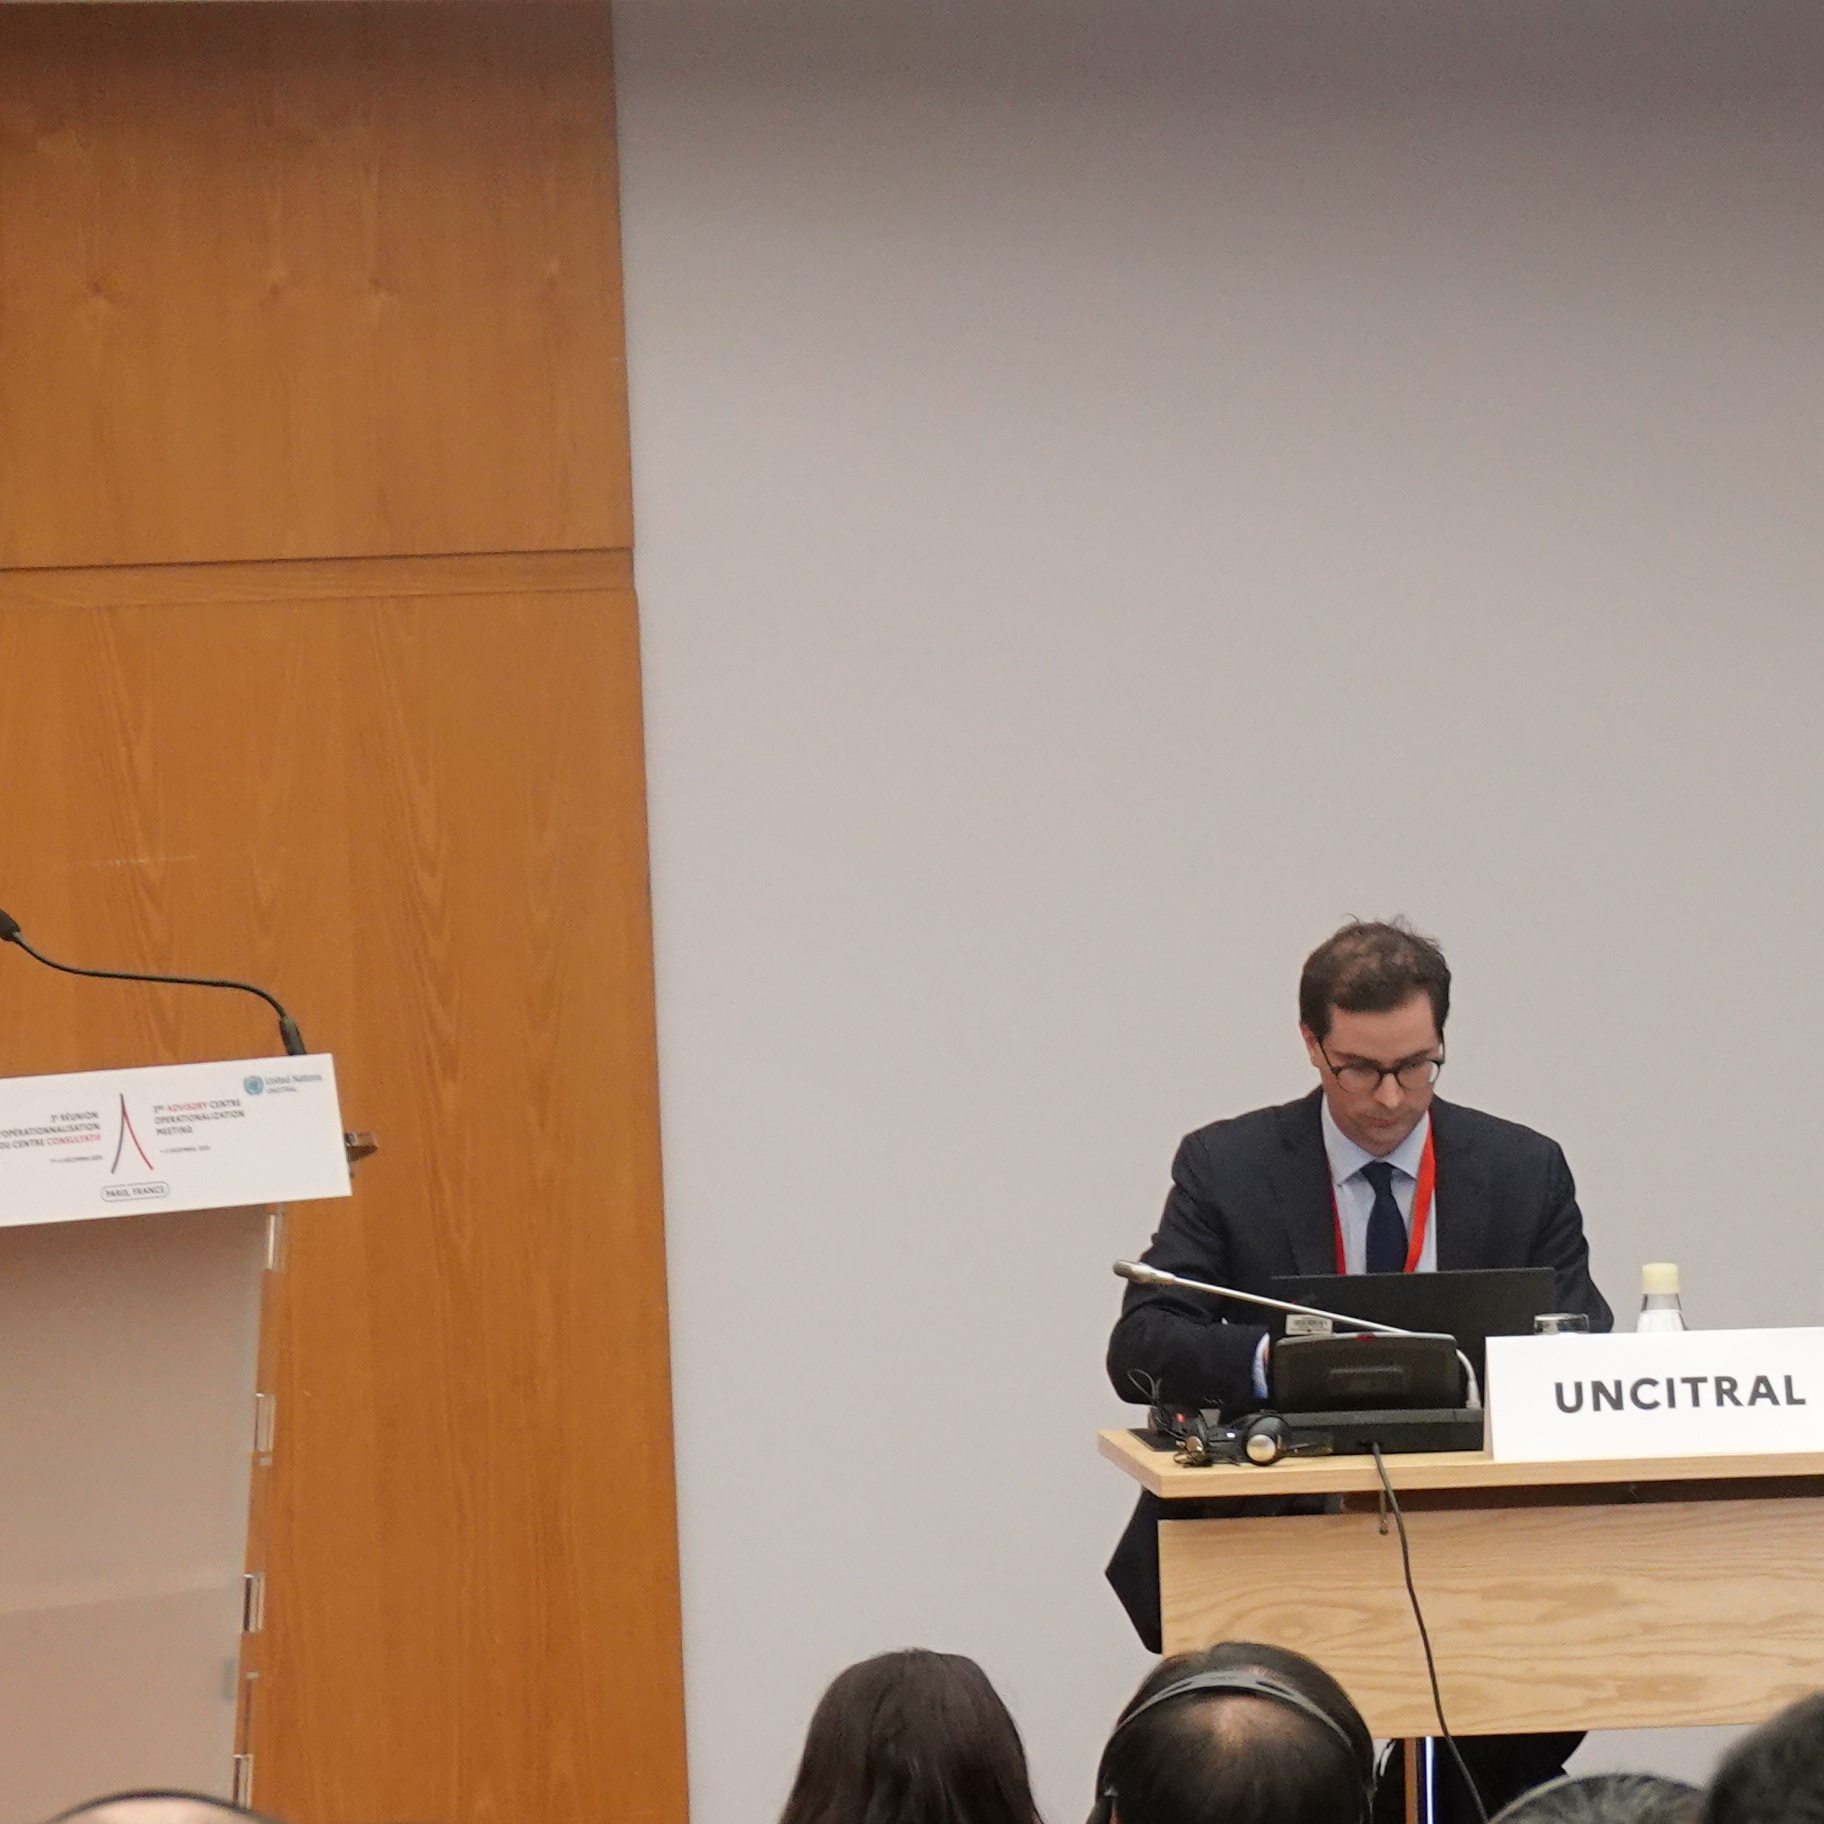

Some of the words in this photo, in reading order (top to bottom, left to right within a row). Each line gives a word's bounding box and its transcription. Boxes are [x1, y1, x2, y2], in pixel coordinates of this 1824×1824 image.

[166, 1101, 209, 1112] ADVISORY
[209, 1098, 241, 1109] CENTRE
[155, 1125, 193, 1136] MEETING
[1553, 1374, 1806, 1413] UNCITRAL
